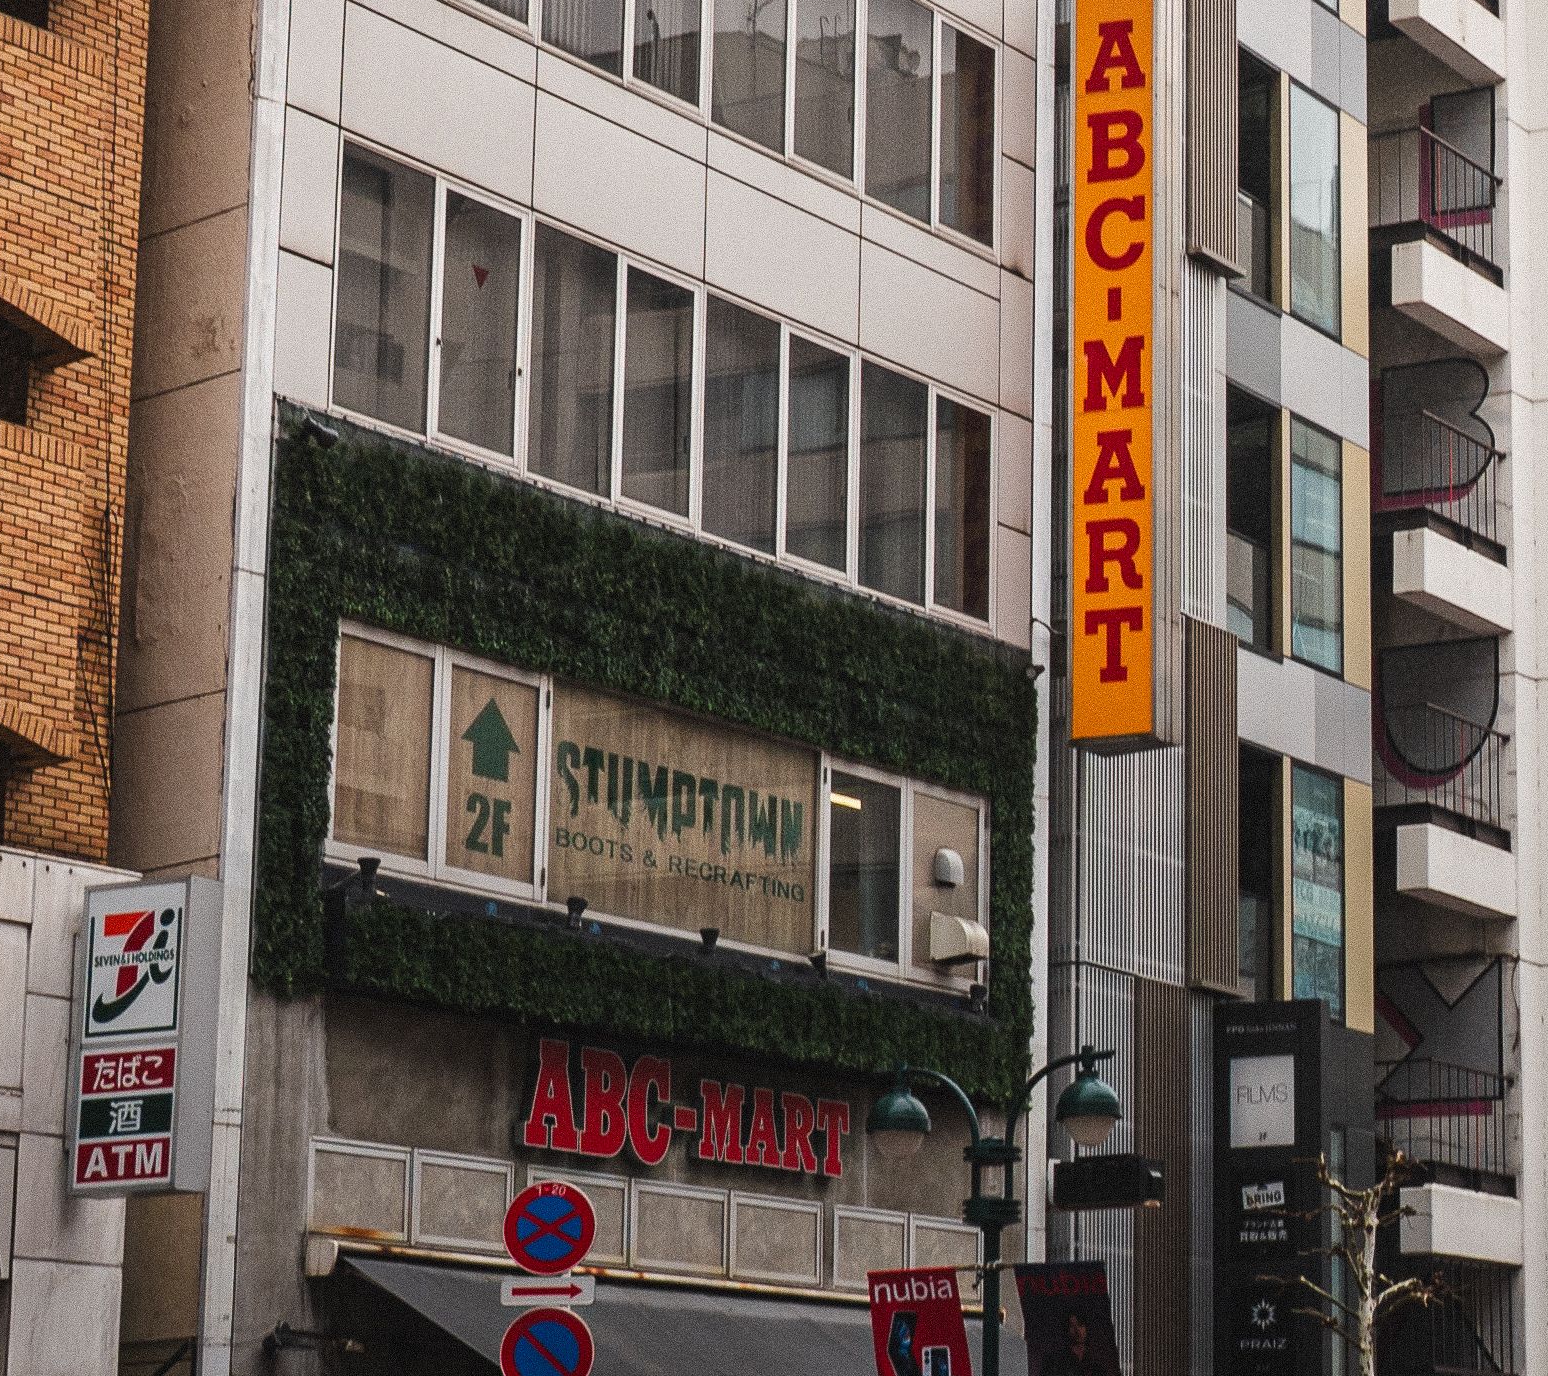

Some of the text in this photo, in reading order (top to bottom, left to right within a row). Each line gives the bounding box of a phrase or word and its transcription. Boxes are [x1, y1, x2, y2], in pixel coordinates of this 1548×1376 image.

[1082, 17, 1146, 688] ABC-MART
[556, 739, 804, 868] STUMPTOWN
[465, 792, 513, 859] 2F
[555, 827, 805, 903] BOOTS & RECRAFTING
[92, 1055, 165, 1091] たばこ
[523, 1038, 851, 1179] ABC-MART
[1236, 1082, 1288, 1105] FILMS
[109, 1099, 144, 1134] 酒
[83, 1143, 164, 1181] ATM
[873, 1274, 954, 1304] nubia
[1239, 1337, 1288, 1350] PRAIZ
